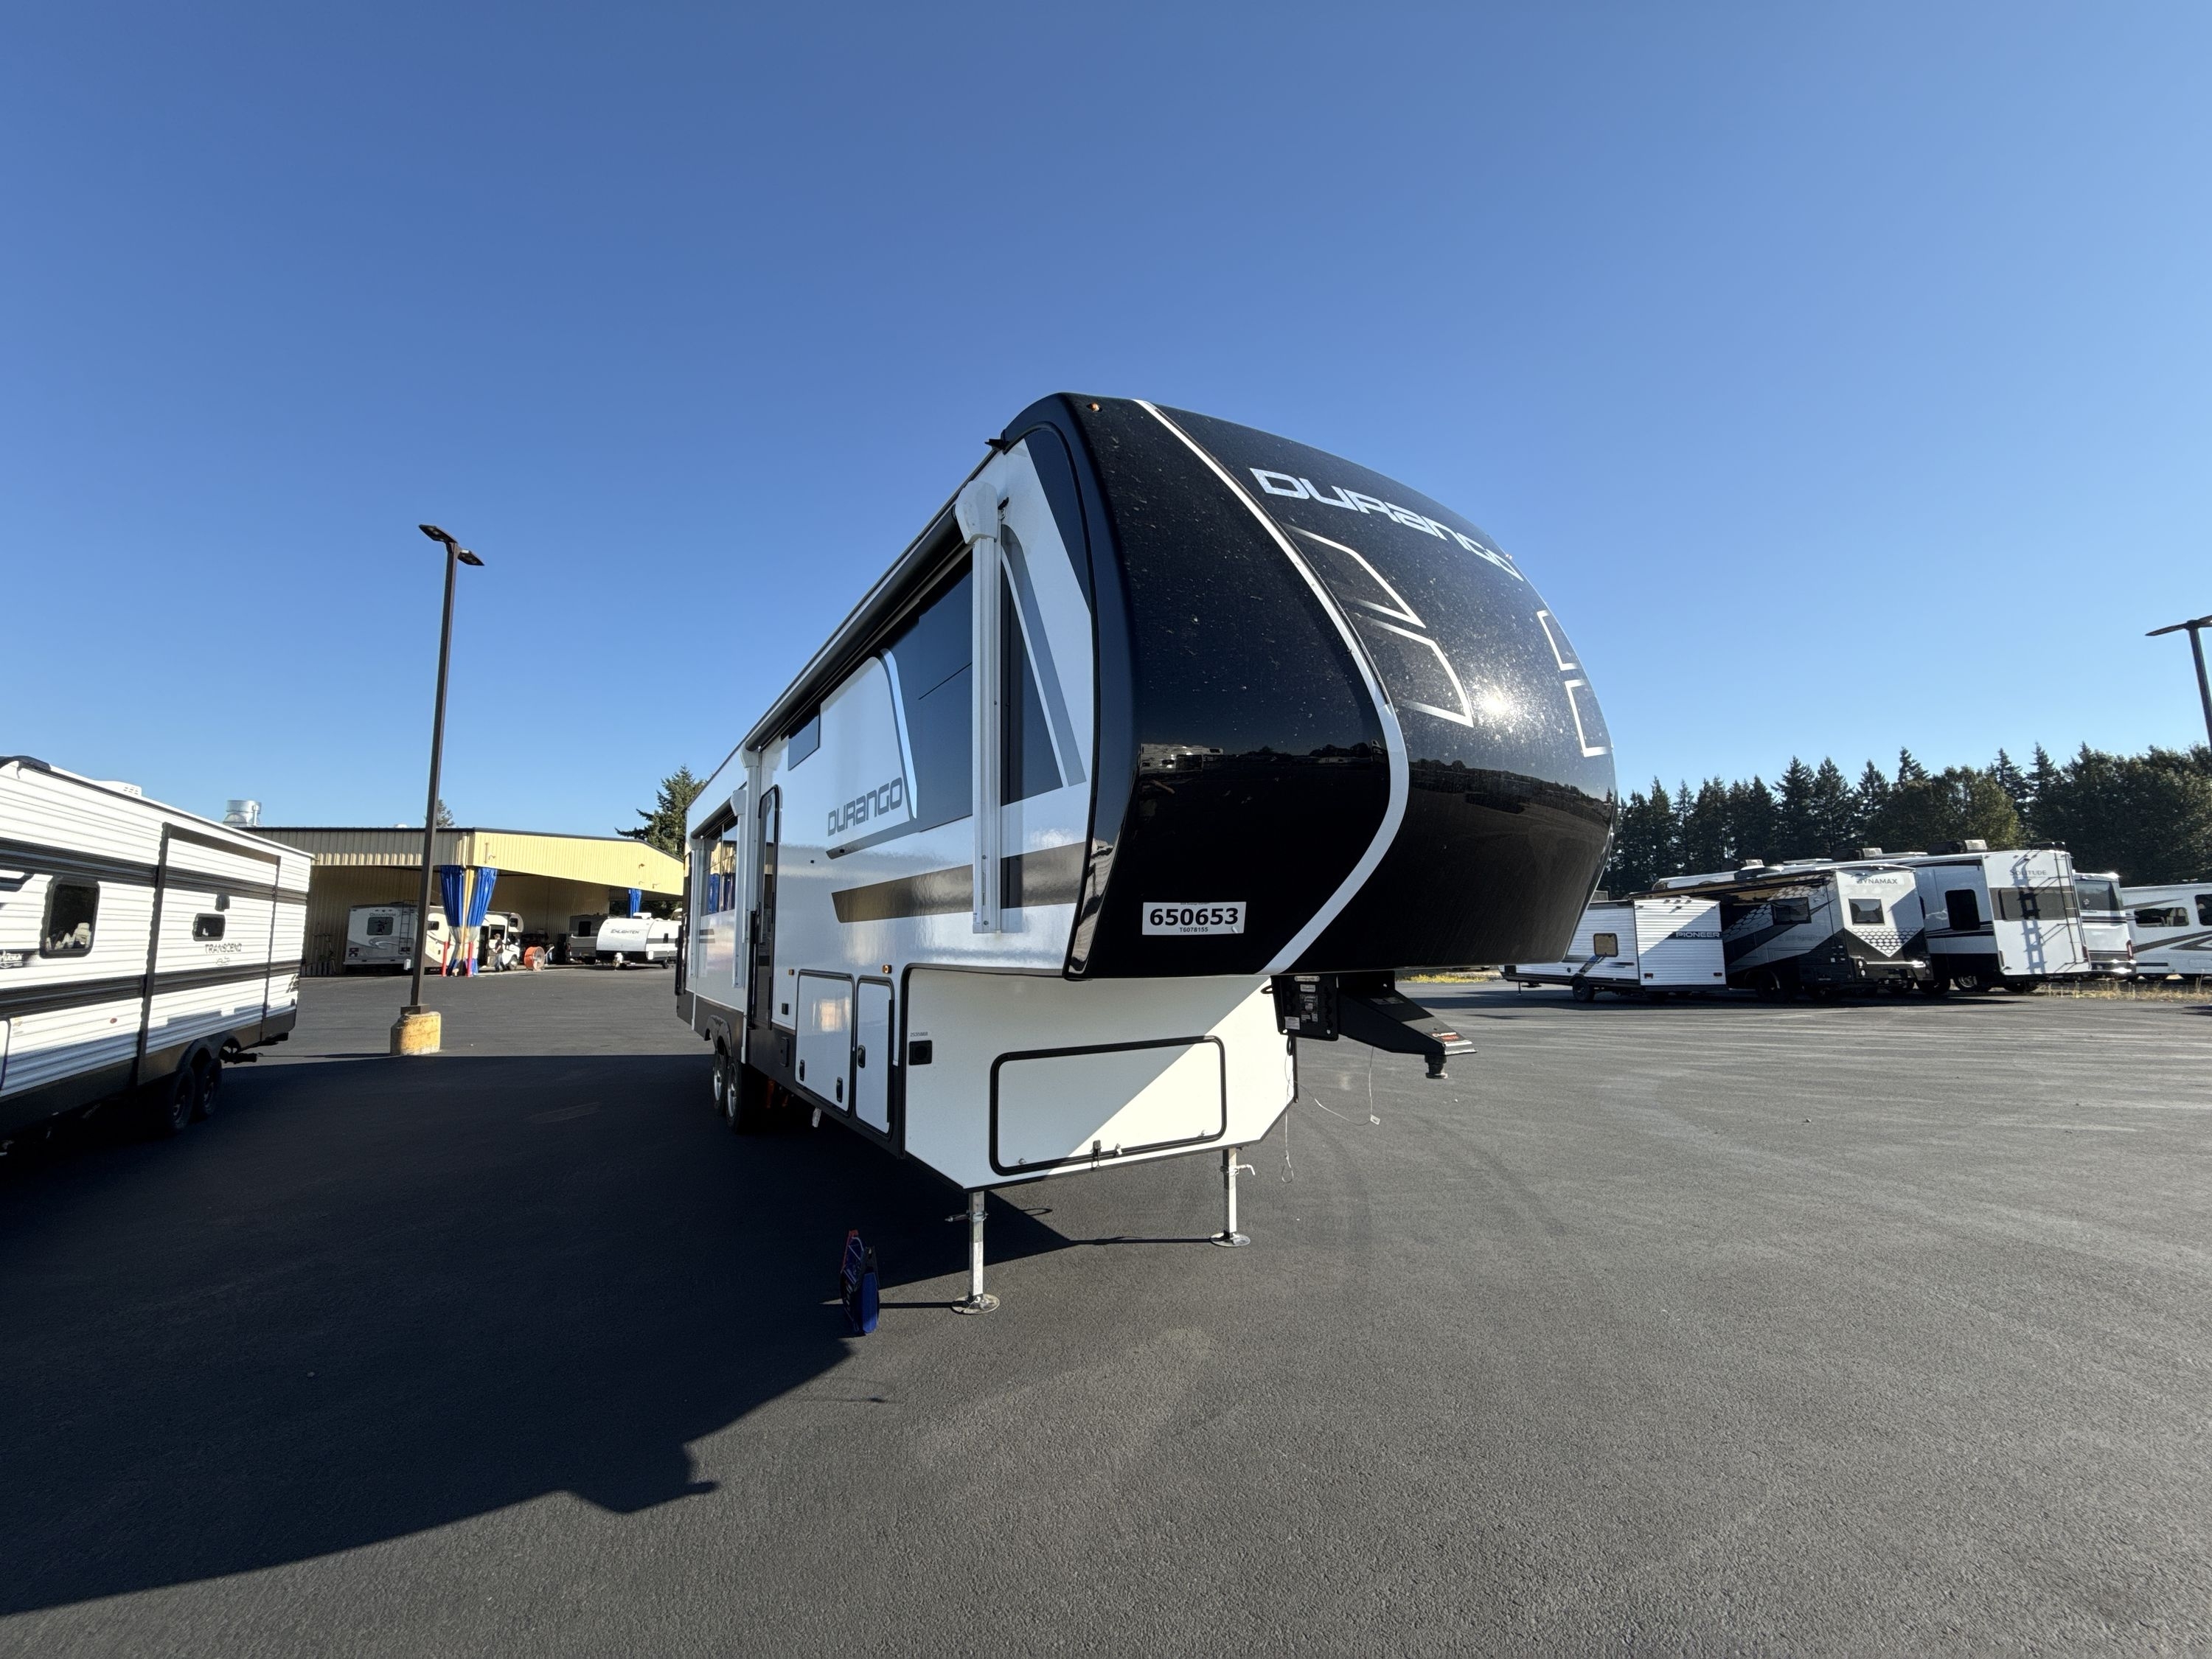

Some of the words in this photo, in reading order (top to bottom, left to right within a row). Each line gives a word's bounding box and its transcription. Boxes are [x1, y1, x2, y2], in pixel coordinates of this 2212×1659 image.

[1249, 467, 1524, 582] DURANGO
[827, 777, 902, 837] DURANGO
[1150, 908, 1239, 926] 650653
[205, 943, 242, 953] TRANSCEND
